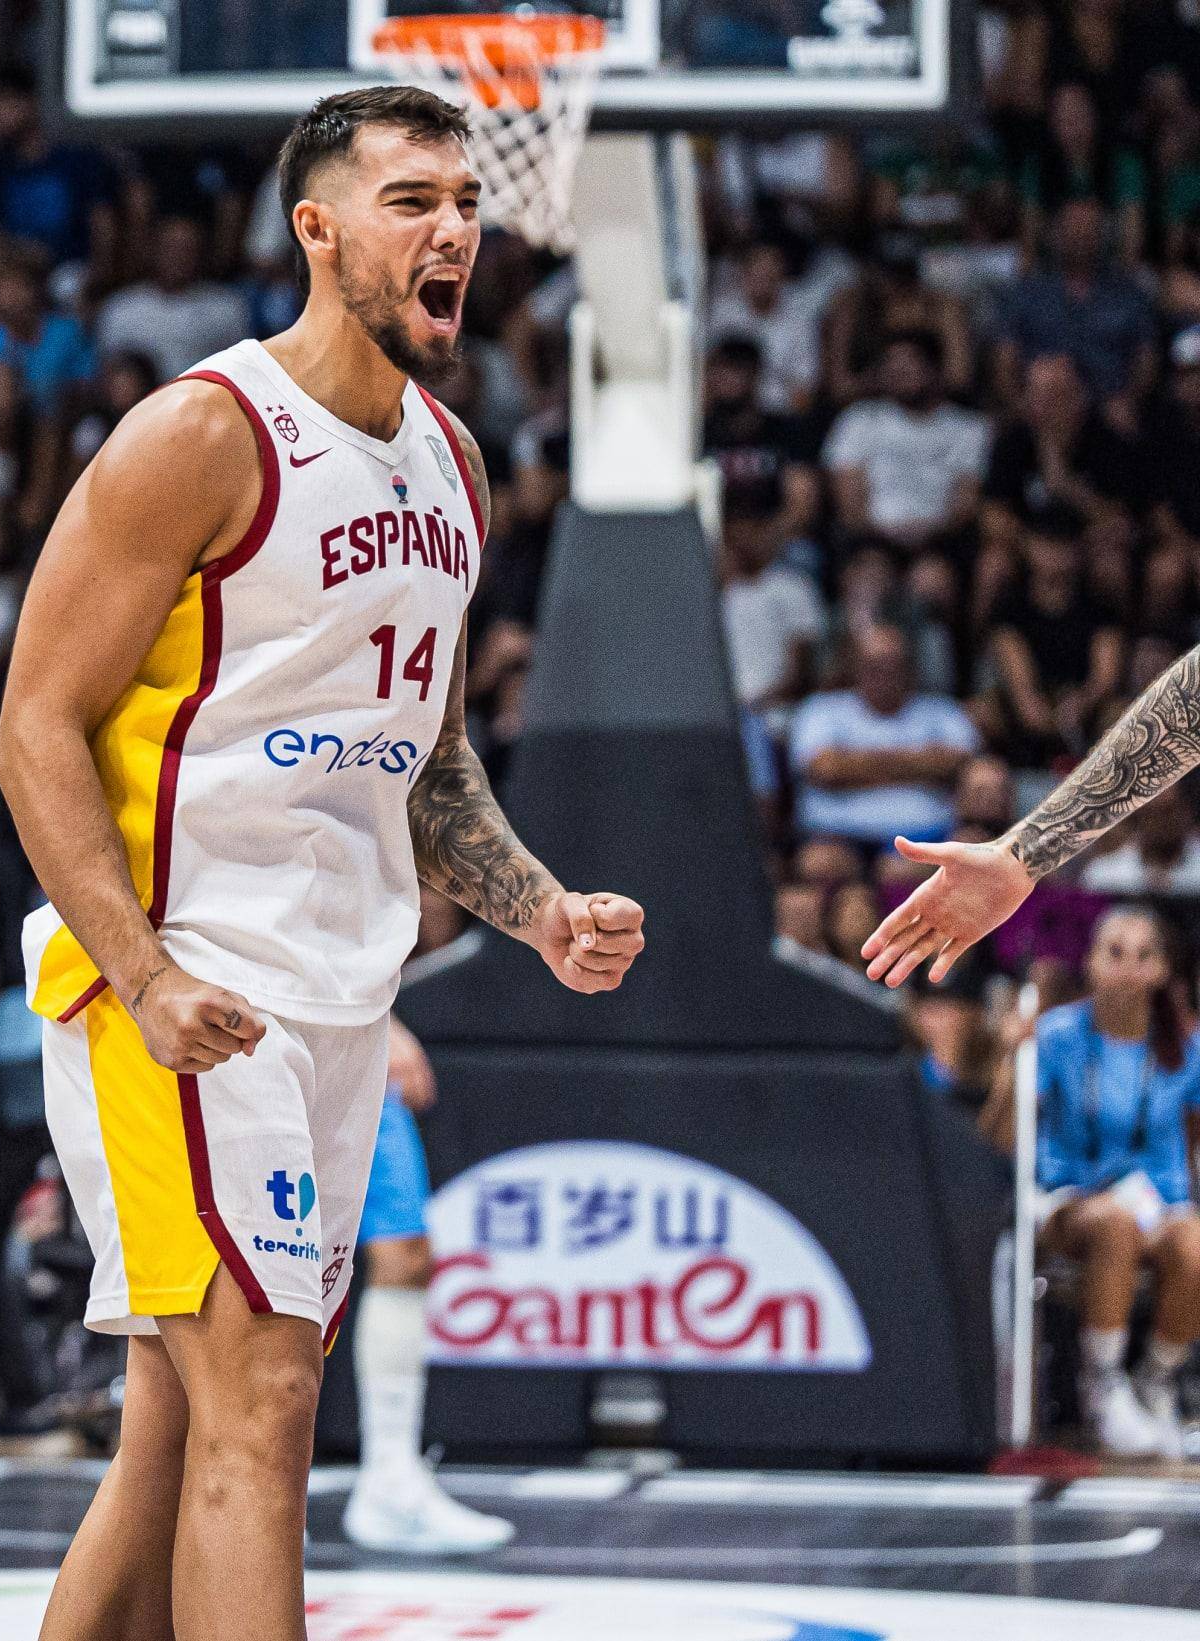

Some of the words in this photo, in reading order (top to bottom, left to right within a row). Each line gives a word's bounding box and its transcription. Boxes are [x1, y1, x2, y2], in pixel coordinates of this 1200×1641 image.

[320, 505, 470, 593] ESPAÑA
[368, 624, 437, 702] 14
[252, 1234, 321, 1262] tenerife
